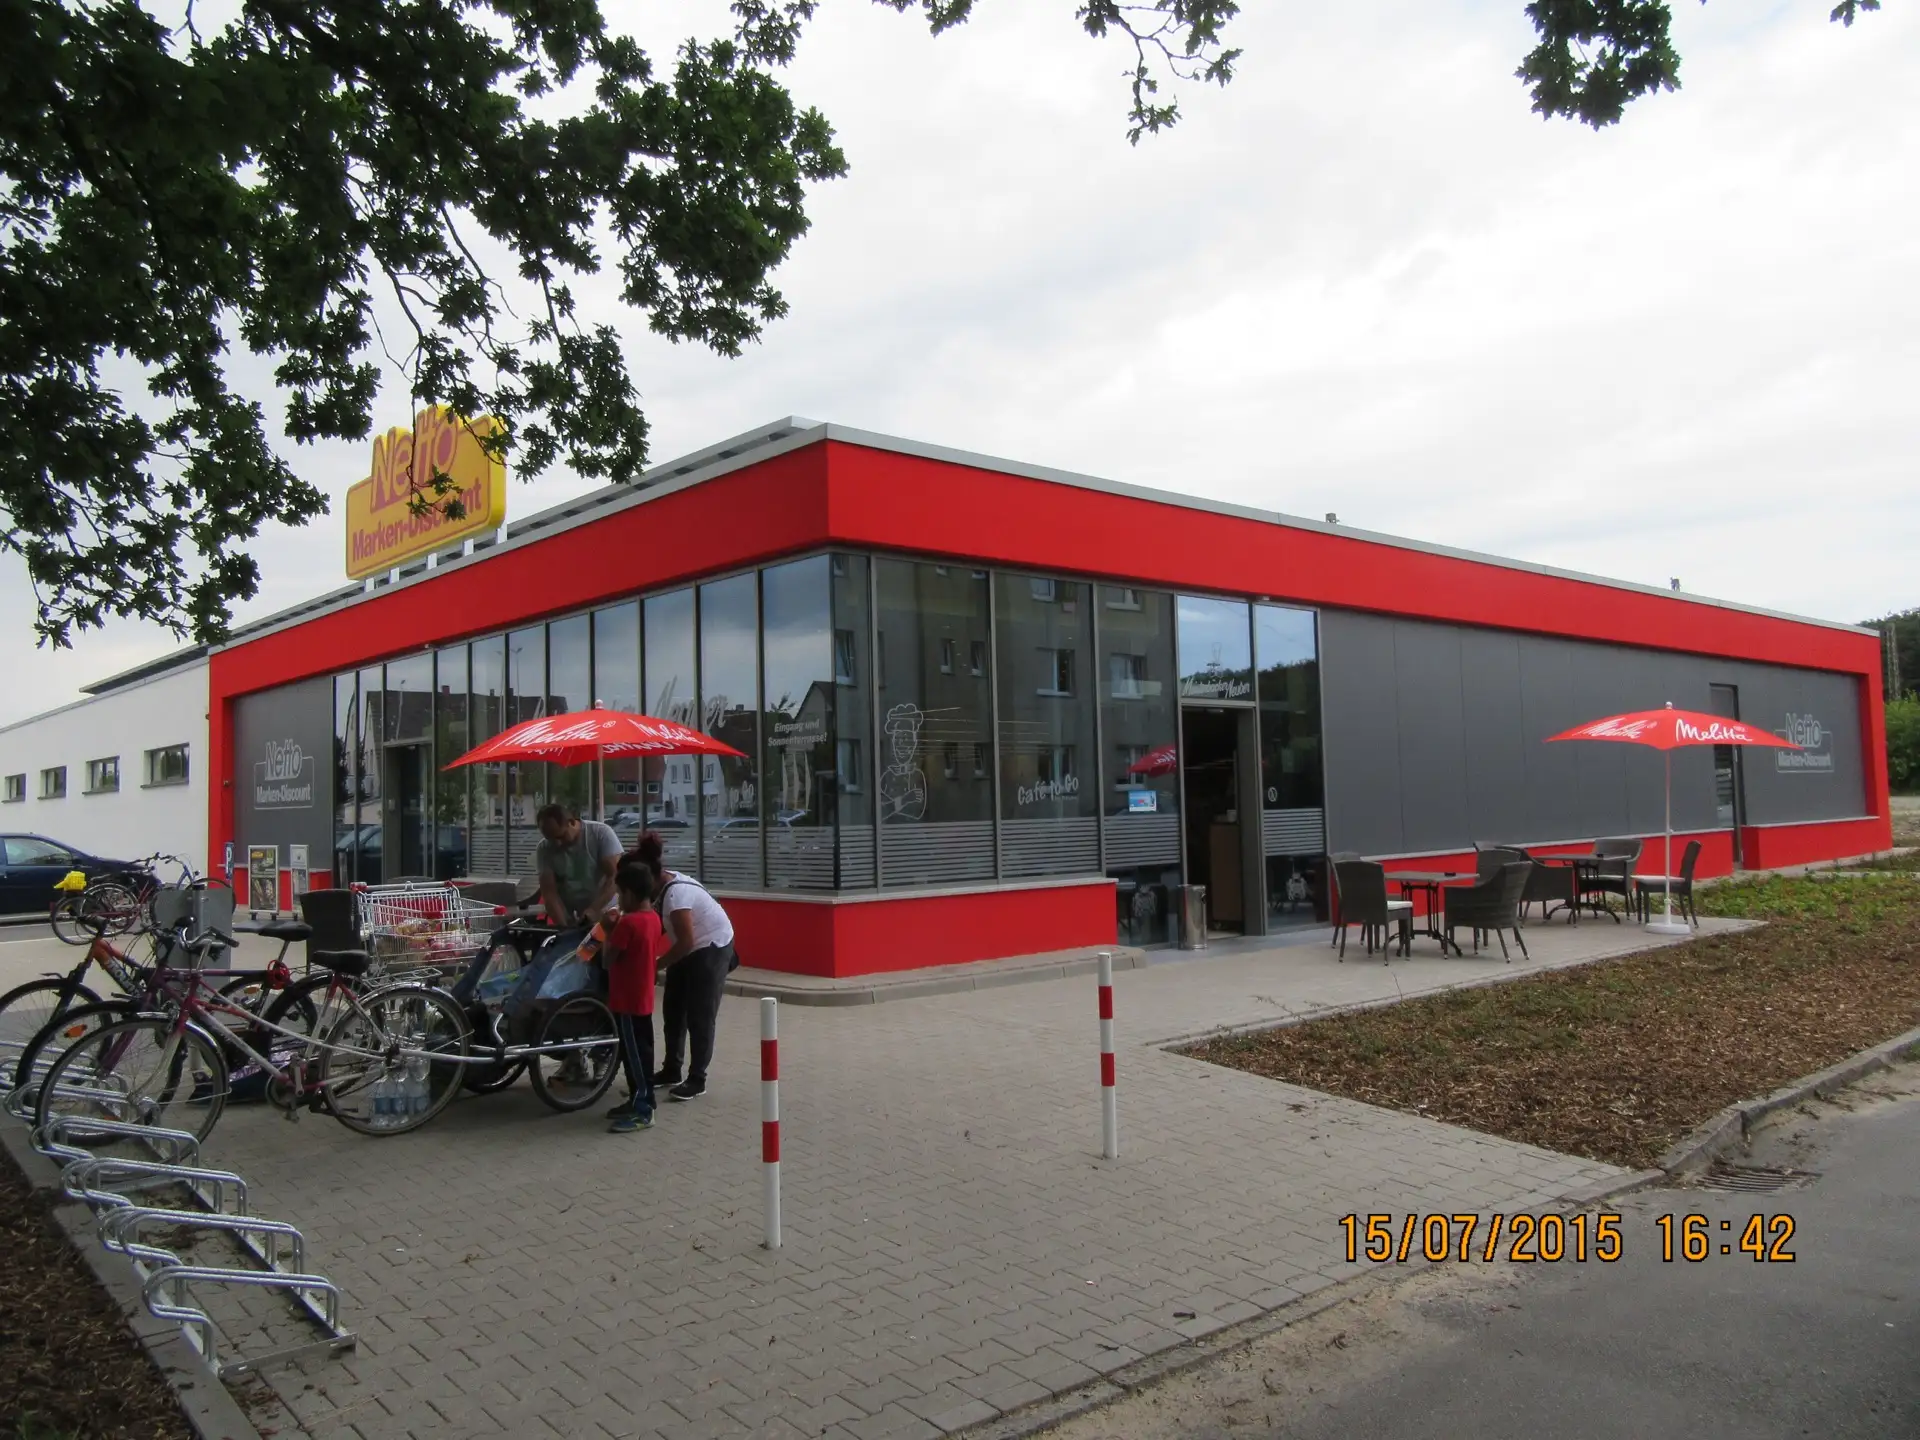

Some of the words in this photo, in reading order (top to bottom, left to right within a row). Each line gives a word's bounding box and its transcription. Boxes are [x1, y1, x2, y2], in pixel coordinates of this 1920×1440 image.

[371, 407, 458, 513] Netto
[352, 477, 482, 562] Marken-Discnt
[488, 718, 602, 753] Melitta
[774, 721, 804, 734] Eingang
[804, 718, 820, 731] und
[1675, 718, 1753, 742] Melitta
[1785, 712, 1822, 747] Netto
[264, 738, 303, 781] Netto
[256, 783, 311, 804] Marken-Discount
[1017, 780, 1046, 806] Café
[1050, 779, 1061, 801] to
[1064, 773, 1079, 793] Go
